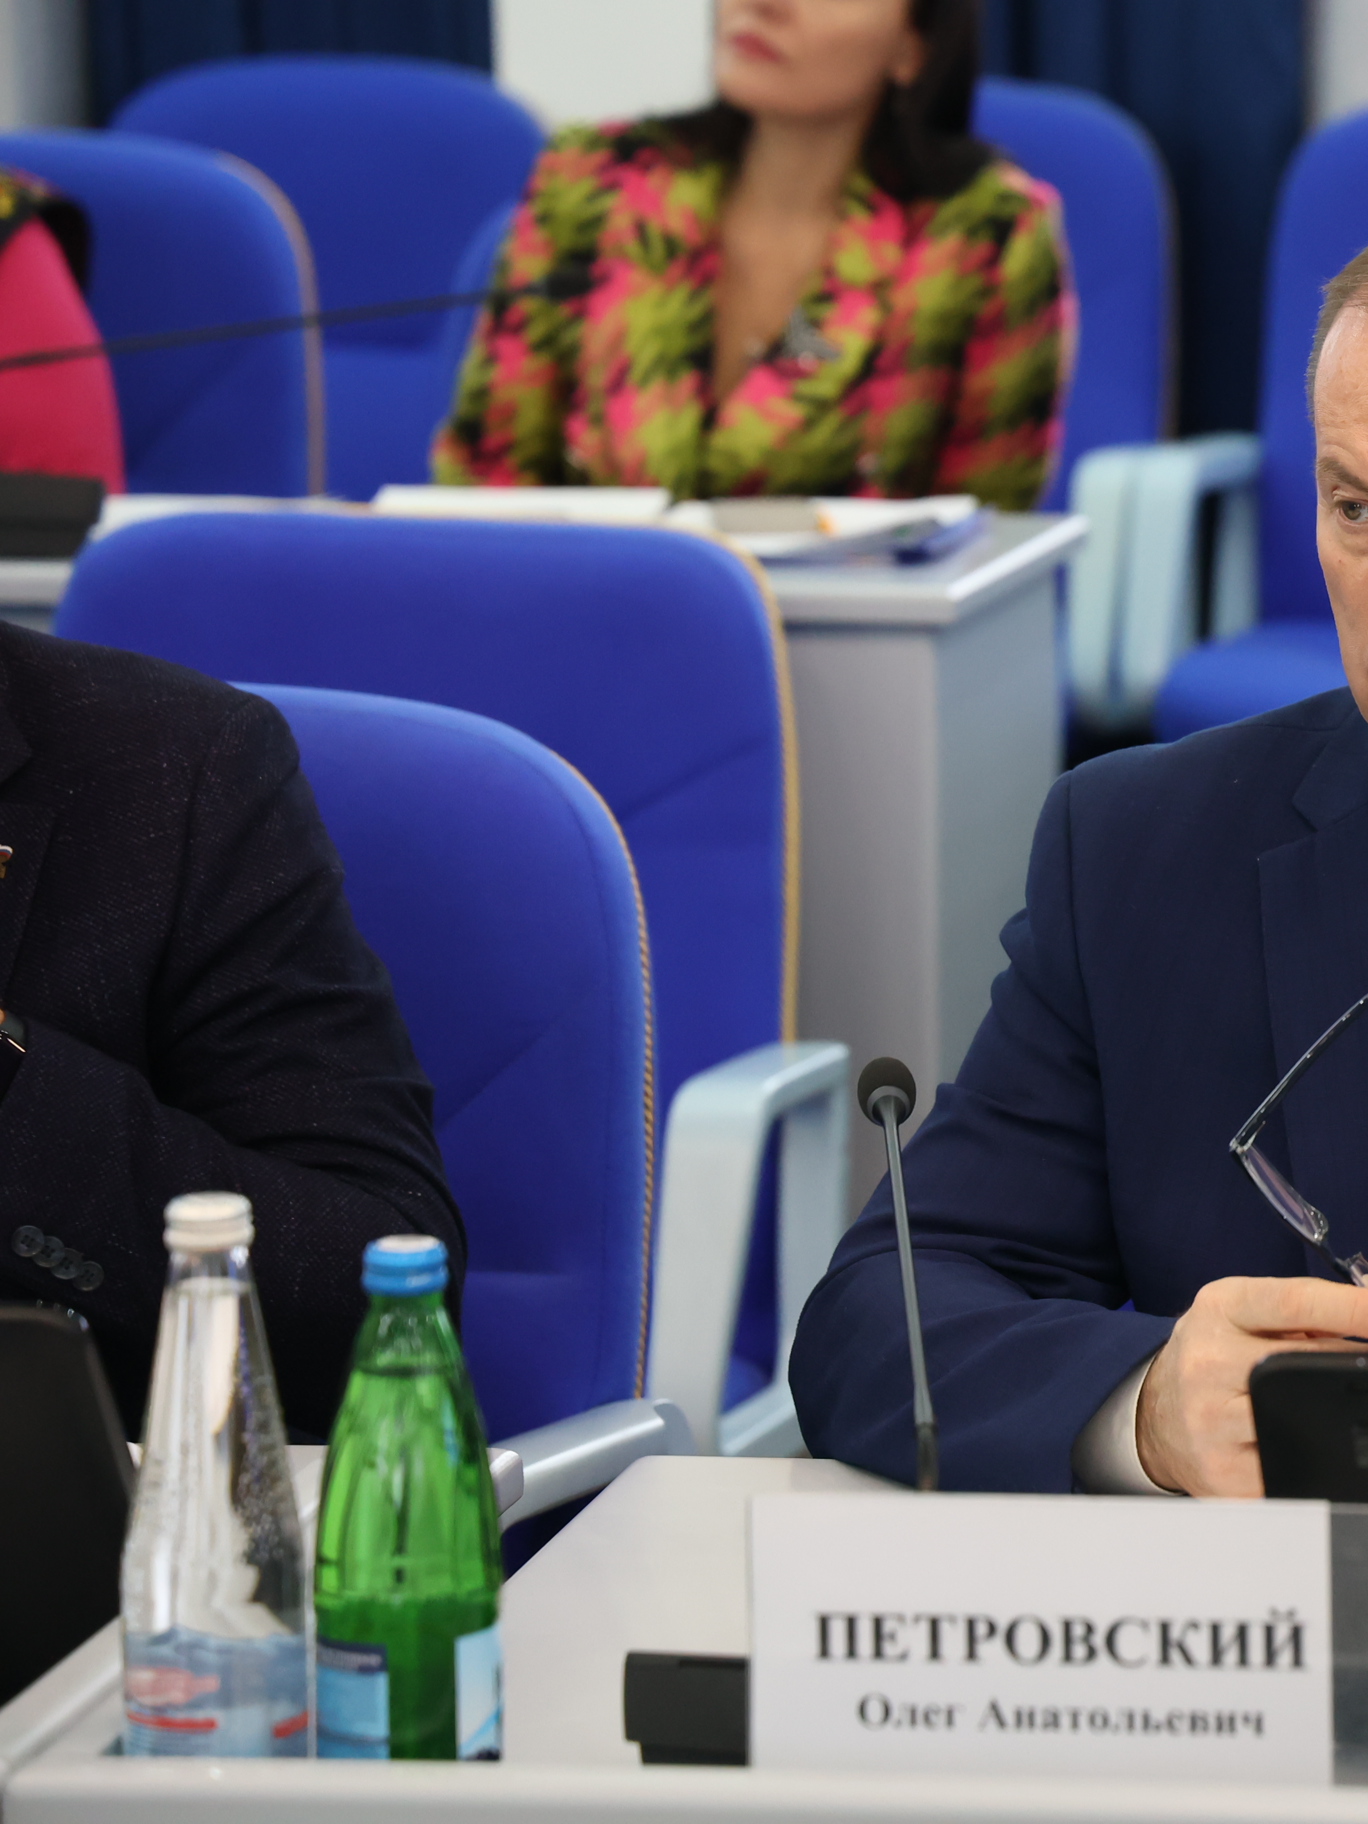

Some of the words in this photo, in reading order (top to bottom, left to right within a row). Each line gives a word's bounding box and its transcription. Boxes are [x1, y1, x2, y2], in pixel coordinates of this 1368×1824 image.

[815, 1607, 1308, 1671] ПЕТРОВСКИЙ
[858, 1693, 960, 1731] Олег
[978, 1697, 1265, 1738] Анатольевич
